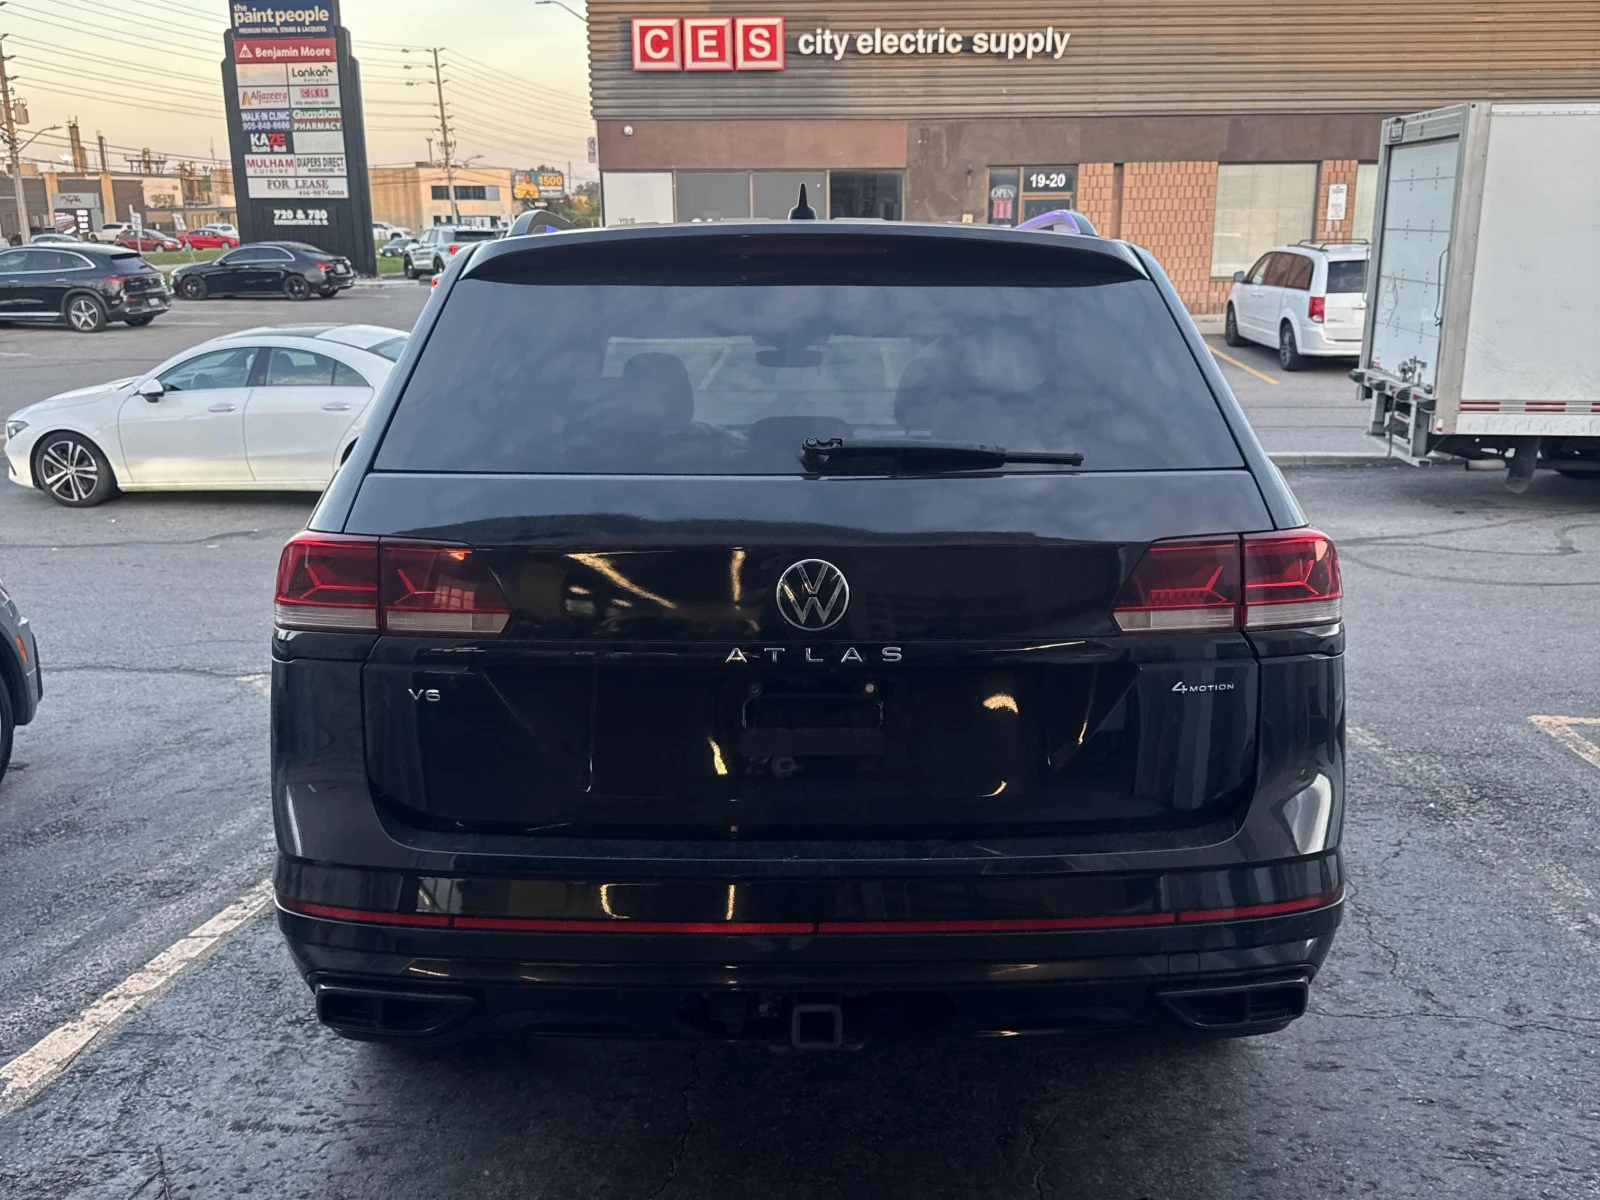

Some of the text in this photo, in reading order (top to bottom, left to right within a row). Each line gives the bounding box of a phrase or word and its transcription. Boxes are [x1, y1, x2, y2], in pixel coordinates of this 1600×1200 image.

[233, 4, 247, 12] the
[234, 6, 330, 27] paint people
[797, 26, 1071, 61] city electric supply
[255, 46, 331, 59] Benjamin Moore
[292, 66, 330, 78] Lankan
[251, 91, 288, 104] Aljazeera
[240, 111, 290, 122] WALK-IN CLINIC
[292, 109, 341, 119] Guardian
[293, 122, 342, 131] PHARMACY
[249, 132, 286, 146] KAZE
[246, 158, 295, 168] MULHAM
[297, 157, 344, 168] DIAPERS DIRECT
[267, 179, 329, 189] FOR LEASE
[1030, 173, 1066, 188] 19-20
[991, 187, 1015, 198] OPEN
[273, 209, 328, 220] 720 & 780
[780, 561, 847, 627] VW
[725, 646, 903, 663] ATLAS
[1171, 681, 1235, 695] 4MOTION
[407, 688, 441, 702] V6
